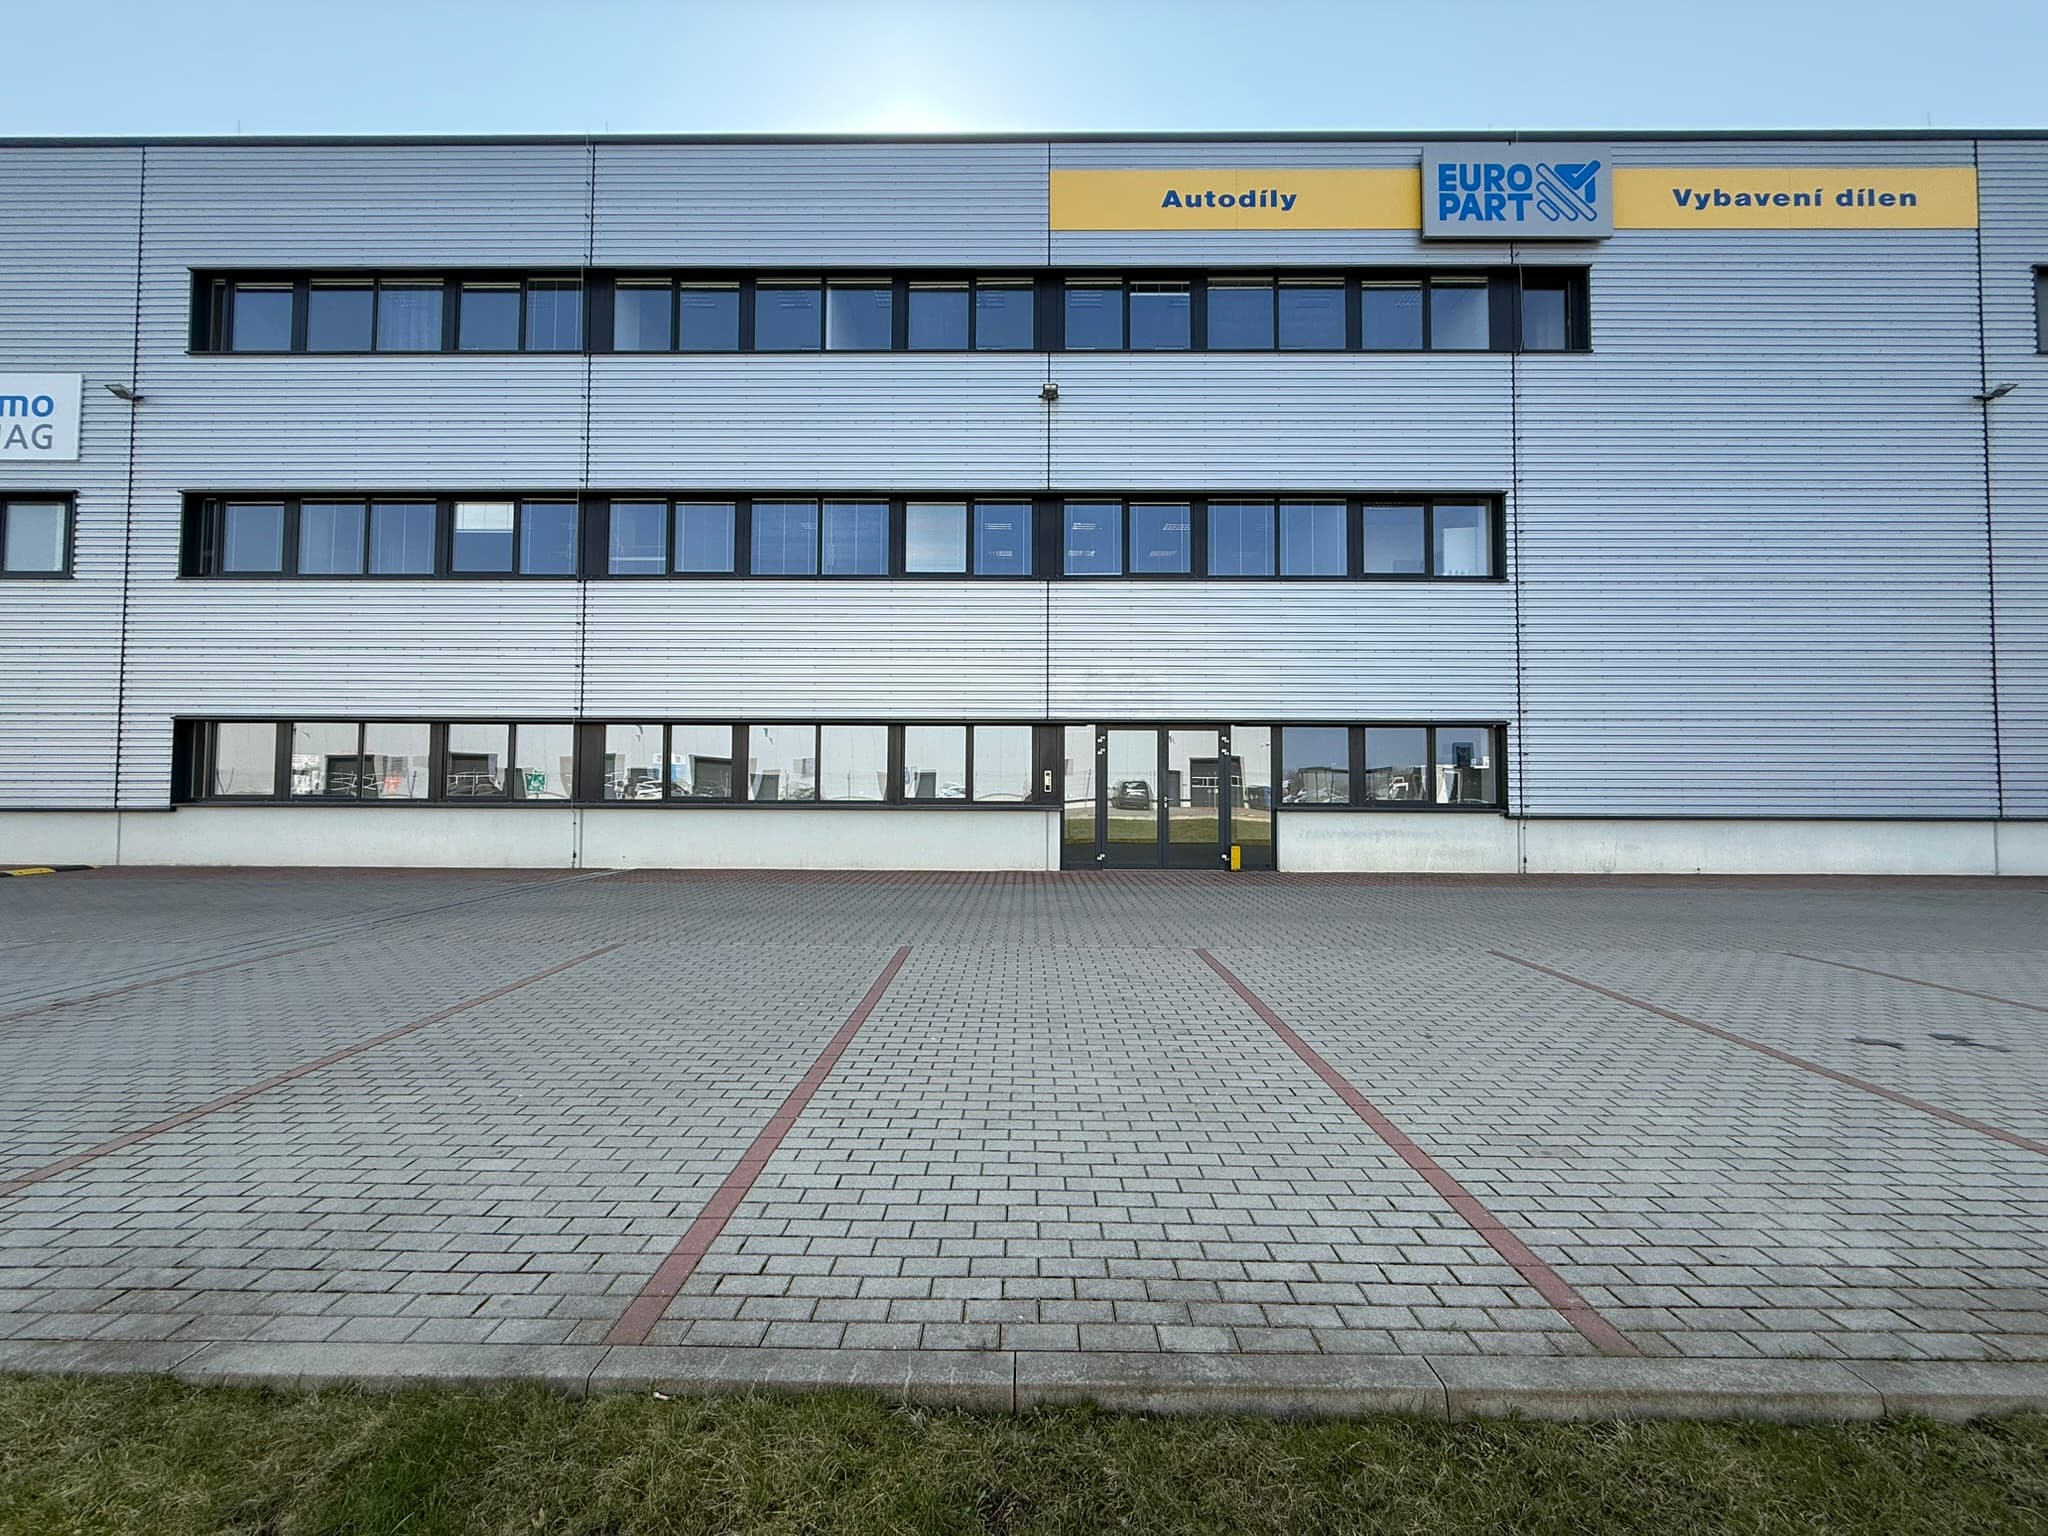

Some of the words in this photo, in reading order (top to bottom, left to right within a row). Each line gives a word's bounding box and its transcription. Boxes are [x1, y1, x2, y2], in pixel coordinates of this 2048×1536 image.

[1438, 163, 1533, 192] EURO
[1162, 189, 1297, 212] Autodíly
[1439, 193, 1533, 221] PART
[1672, 188, 1824, 210] Vybavení
[1834, 188, 1918, 207] dílen
[0, 423, 53, 449] AG
